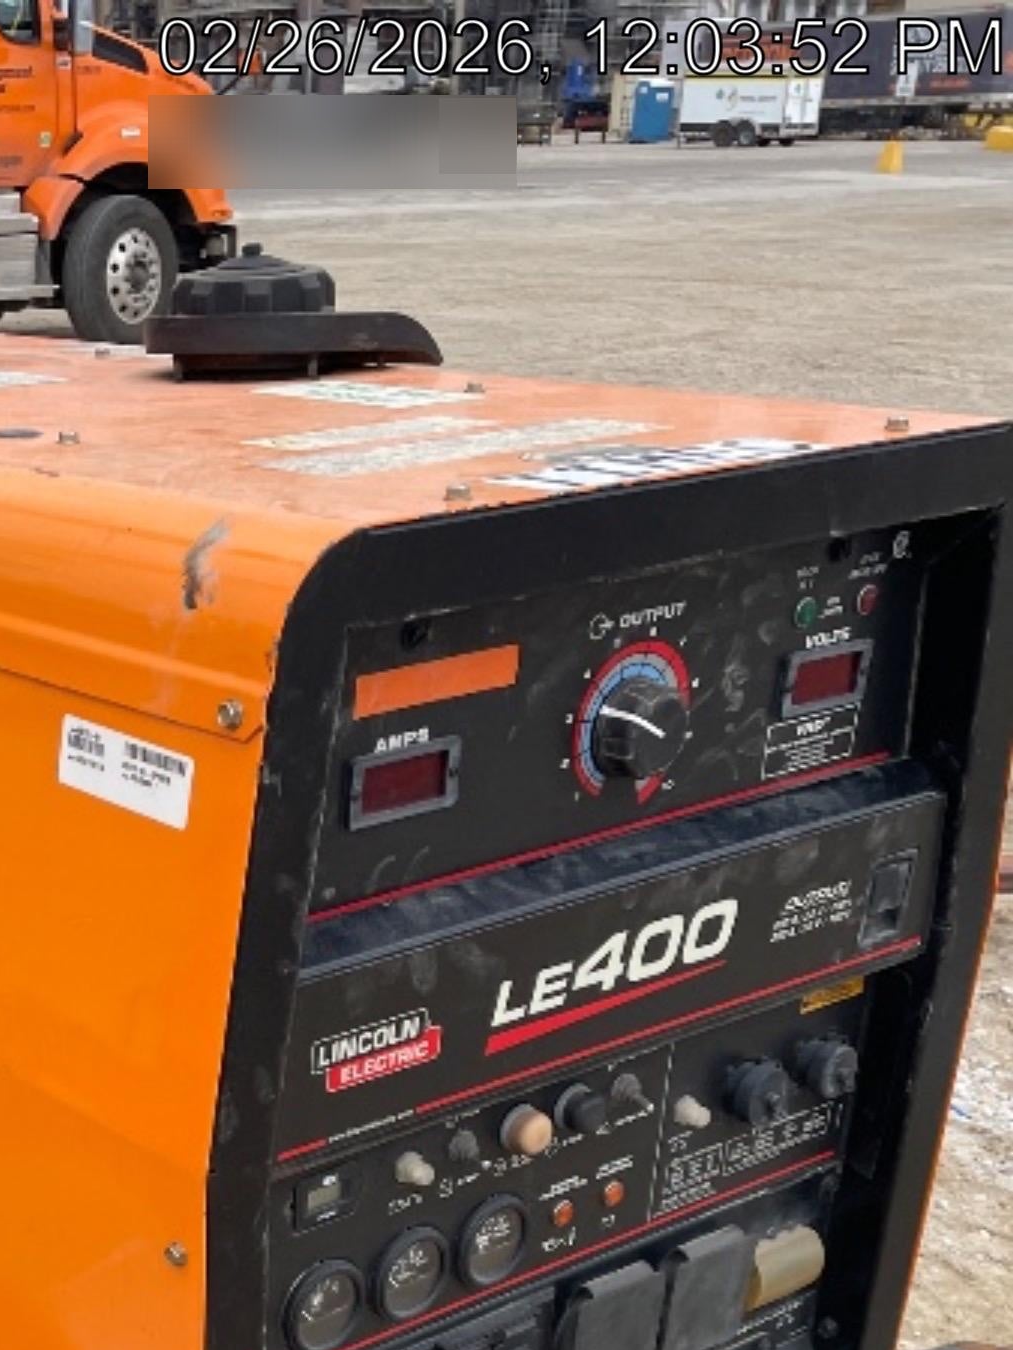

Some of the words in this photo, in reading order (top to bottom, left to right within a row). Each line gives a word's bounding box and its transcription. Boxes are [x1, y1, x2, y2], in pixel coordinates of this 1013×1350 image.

[619, 601, 686, 628] OUTPUT
[374, 728, 429, 754] AMPS
[490, 899, 738, 1027] LE400
[319, 1016, 420, 1067] LINCOLN
[340, 1040, 429, 1084] ELECTRIC
